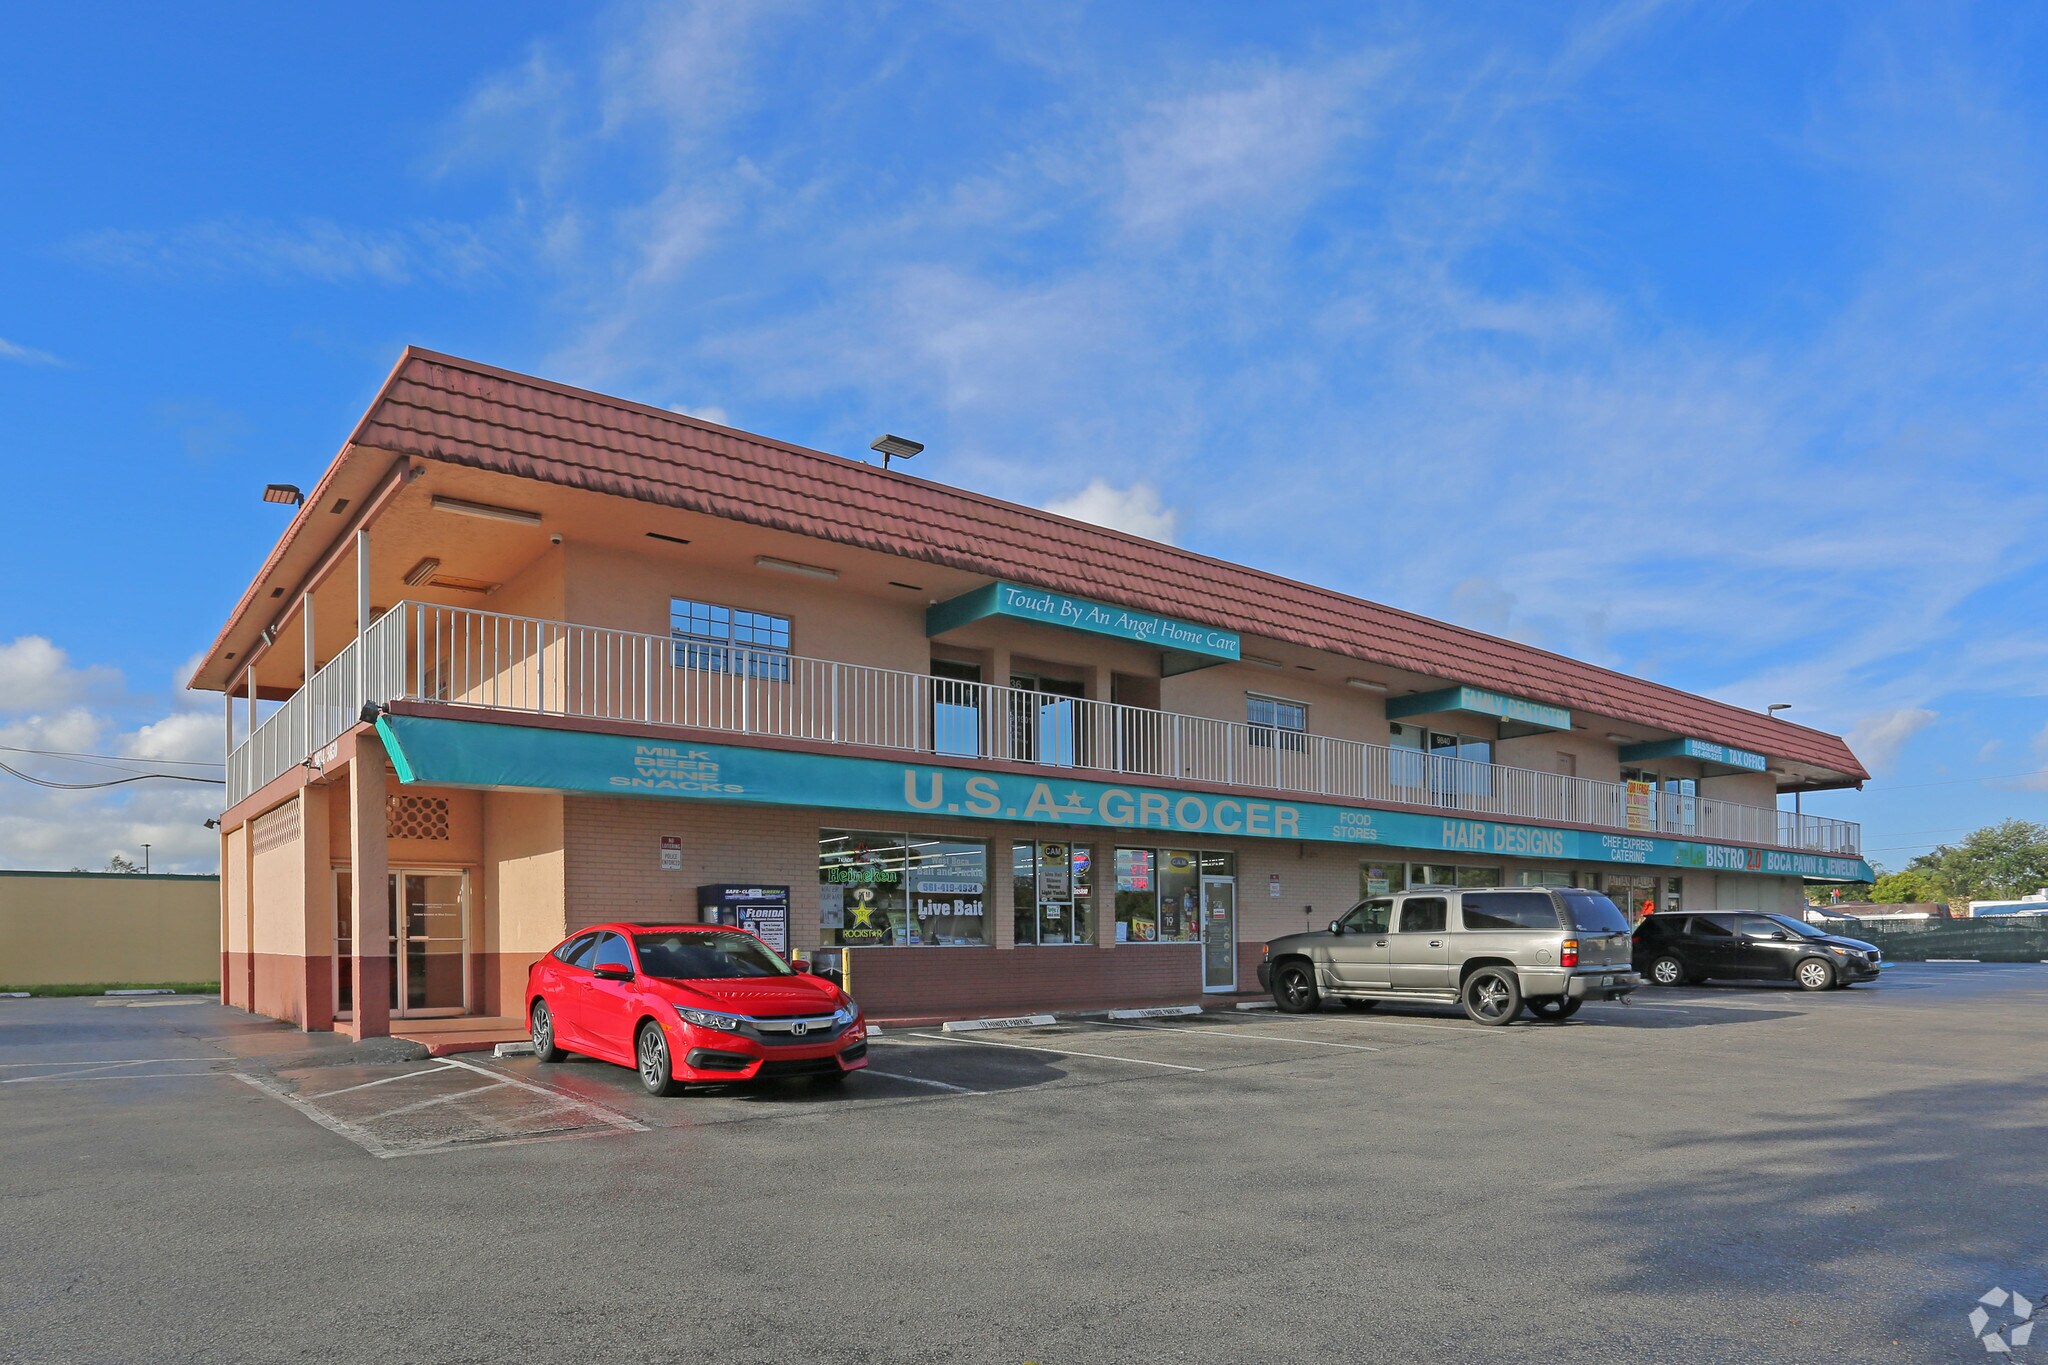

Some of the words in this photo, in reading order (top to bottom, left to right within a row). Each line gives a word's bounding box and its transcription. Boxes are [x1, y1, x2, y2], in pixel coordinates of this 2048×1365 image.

[1005, 587, 1055, 614] Touch
[1060, 600, 1083, 625] By
[1085, 606, 1110, 625] An
[1115, 612, 1158, 640] Angel
[1161, 621, 1203, 644] Home
[1206, 632, 1237, 651] Care
[1462, 687, 1503, 714] FAMILY
[1508, 698, 1570, 729] DENTISTRY
[636, 745, 711, 761] MILK
[1691, 740, 1722, 755] MASSAGE
[634, 757, 719, 771] BEER
[1728, 748, 1743, 766] TAX
[1743, 753, 1766, 772] OFFICE
[636, 767, 719, 782] WINE
[609, 776, 745, 793] SNACKS
[1099, 789, 1300, 837] GROCER
[1340, 812, 1372, 826] FOOD
[1332, 826, 1377, 841] STORES
[1442, 820, 1486, 849] HAIR
[1493, 825, 1563, 855] DESIGNS
[1045, 847, 1061, 855] CAM
[1602, 835, 1622, 848] CHEF
[1623, 837, 1654, 852] EXPRESS
[931, 856, 950, 865] West
[951, 857, 970, 865] Boca
[1611, 848, 1646, 863] CATERING
[1690, 845, 1704, 865] Le
[1706, 845, 1744, 869] BISTRO
[1746, 849, 1762, 870] 2.0
[917, 866, 935, 876] Bait
[936, 867, 952, 876] and
[1767, 852, 1791, 872] BOCA
[1793, 855, 1816, 874] PAWN
[1818, 858, 1824, 874] &
[1826, 859, 1859, 877] JEWELRY
[827, 867, 898, 883] Heineken
[745, 908, 784, 918] FLORIDA
[917, 898, 951, 916] Live
[953, 899, 984, 916] Bait
[1009, 1018, 1034, 1027] PARKING
